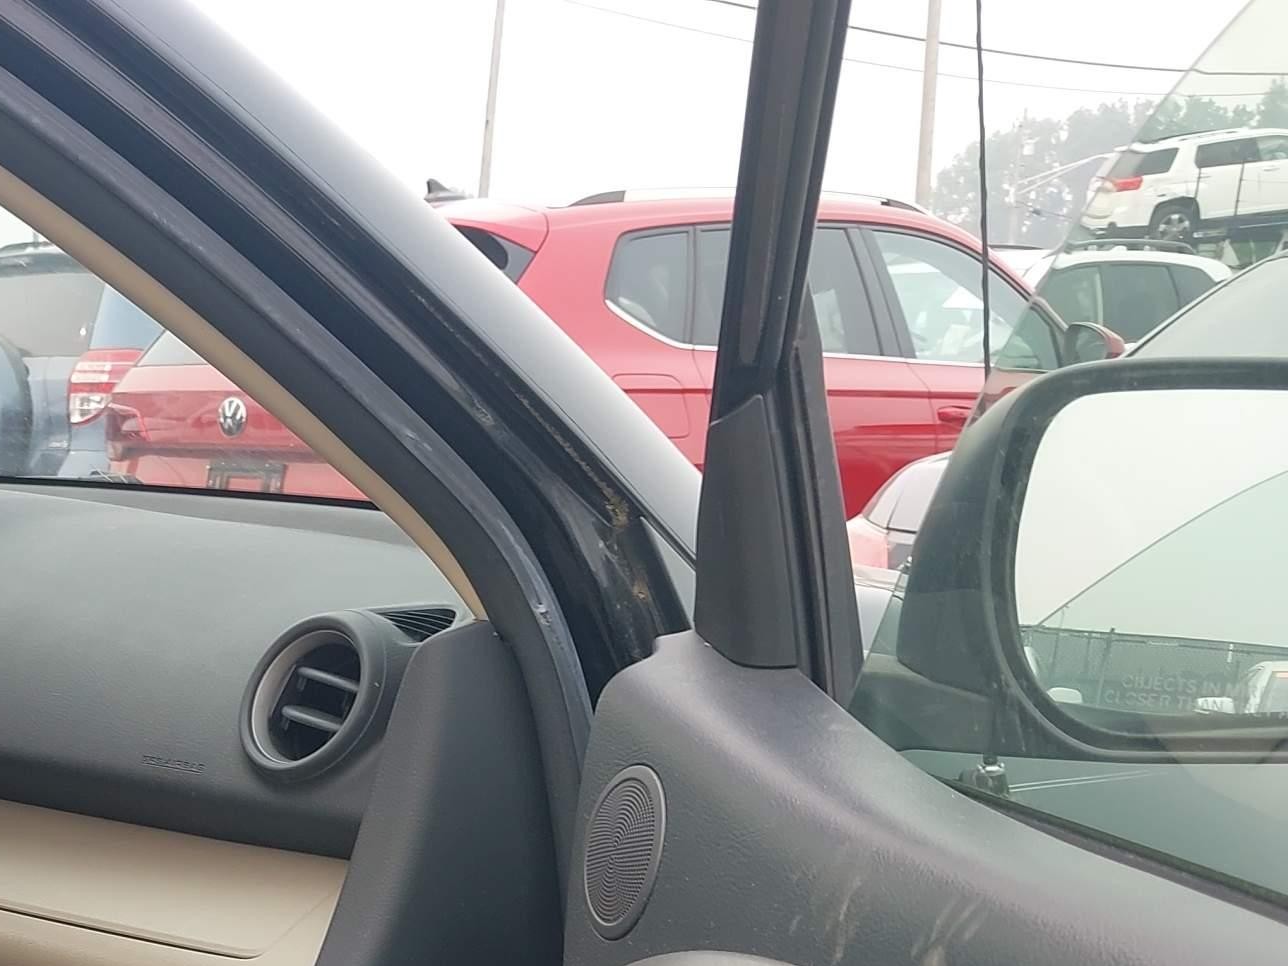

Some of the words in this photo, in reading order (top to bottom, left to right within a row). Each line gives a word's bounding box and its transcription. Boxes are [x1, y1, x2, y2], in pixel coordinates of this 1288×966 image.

[1121, 673, 1198, 694] OBJECTS
[1201, 681, 1221, 696] IN
[1103, 688, 1170, 708] CLOSER
